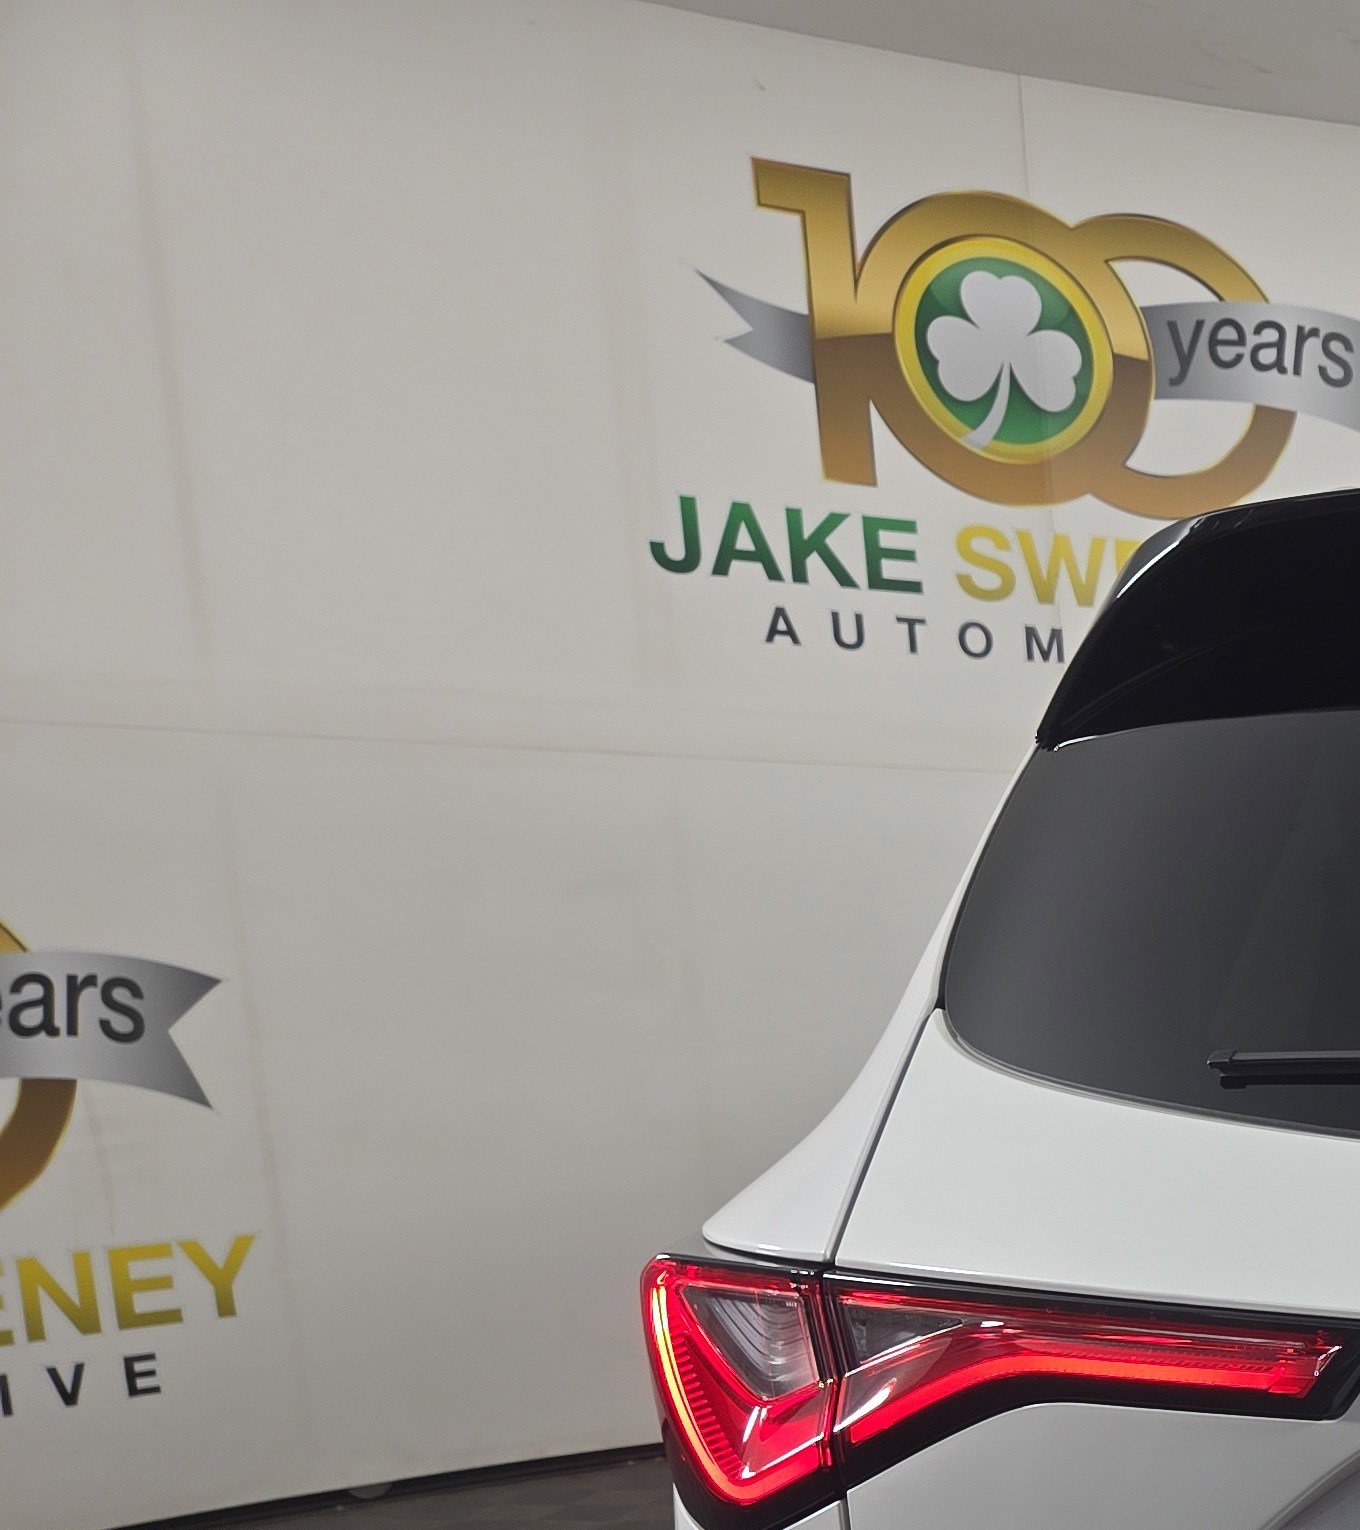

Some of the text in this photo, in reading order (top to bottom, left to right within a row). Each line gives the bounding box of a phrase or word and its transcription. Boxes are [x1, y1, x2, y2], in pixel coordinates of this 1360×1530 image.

[1166, 315, 1356, 389] years
[649, 495, 1149, 607] JAKE SW
[764, 605, 1067, 664] AUTOM
[0, 971, 146, 1045] ars
[0, 1234, 257, 1348] NEY
